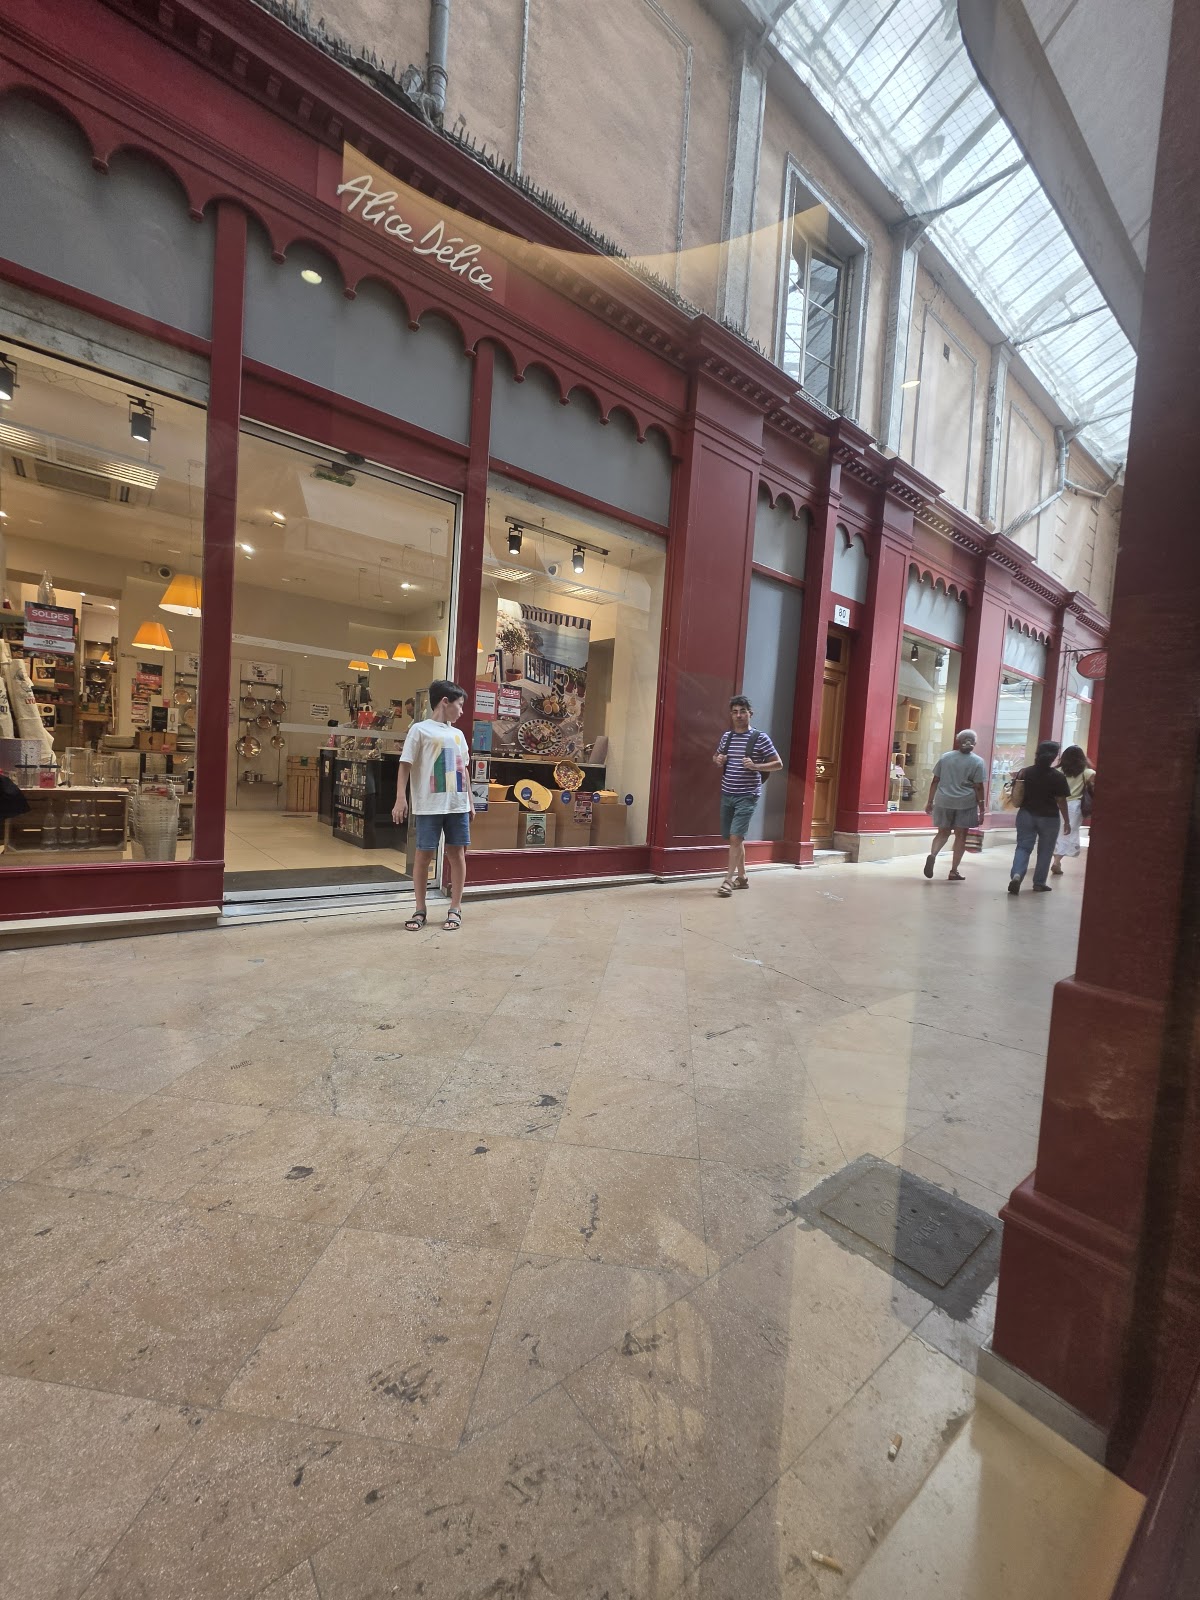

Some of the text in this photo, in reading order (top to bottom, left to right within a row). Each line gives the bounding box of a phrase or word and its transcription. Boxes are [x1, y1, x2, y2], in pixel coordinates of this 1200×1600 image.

[336, 175, 493, 292] Alice Délice
[31, 609, 70, 621] SOLDES
[502, 688, 520, 696] SOLDES
